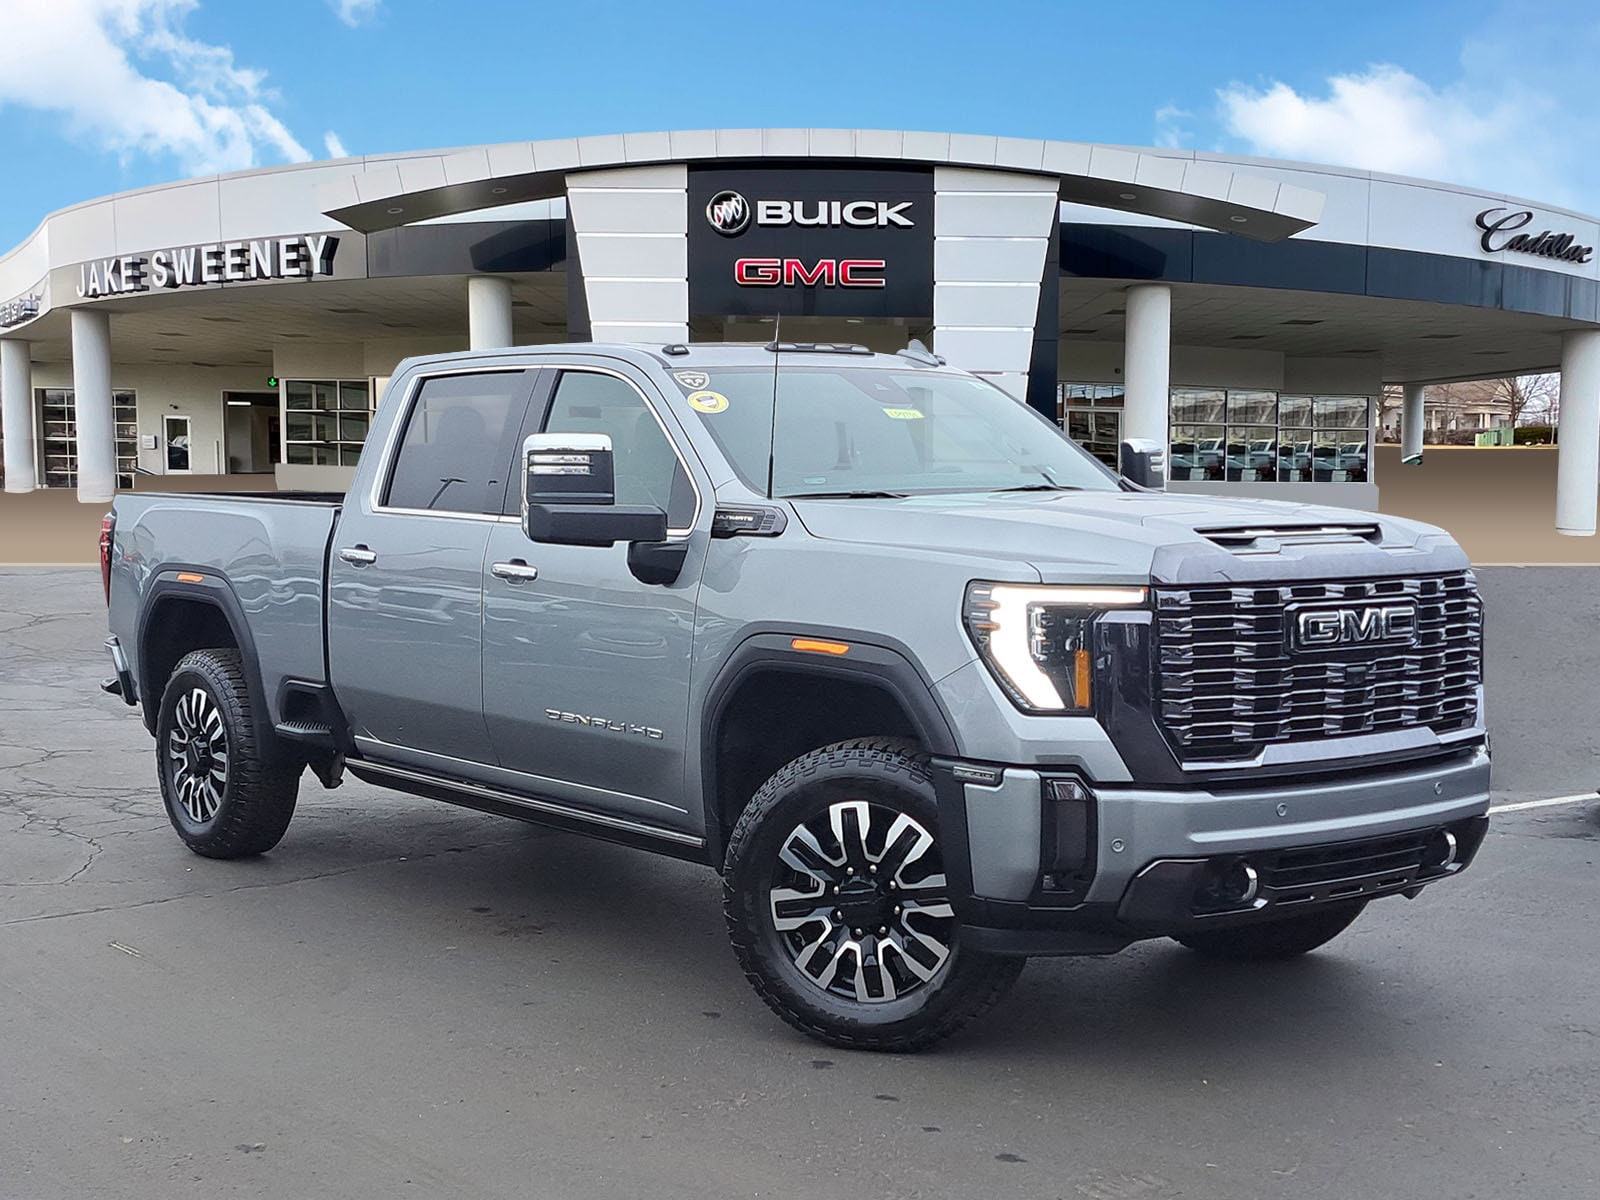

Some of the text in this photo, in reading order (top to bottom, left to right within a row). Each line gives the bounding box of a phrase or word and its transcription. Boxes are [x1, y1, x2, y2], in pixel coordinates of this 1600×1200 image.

[757, 200, 914, 226] BUICK
[1475, 207, 1593, 264] Cadillac
[76, 235, 332, 298] JAKE SWEENEY
[735, 258, 886, 287] GMC
[1299, 606, 1415, 645] GMC
